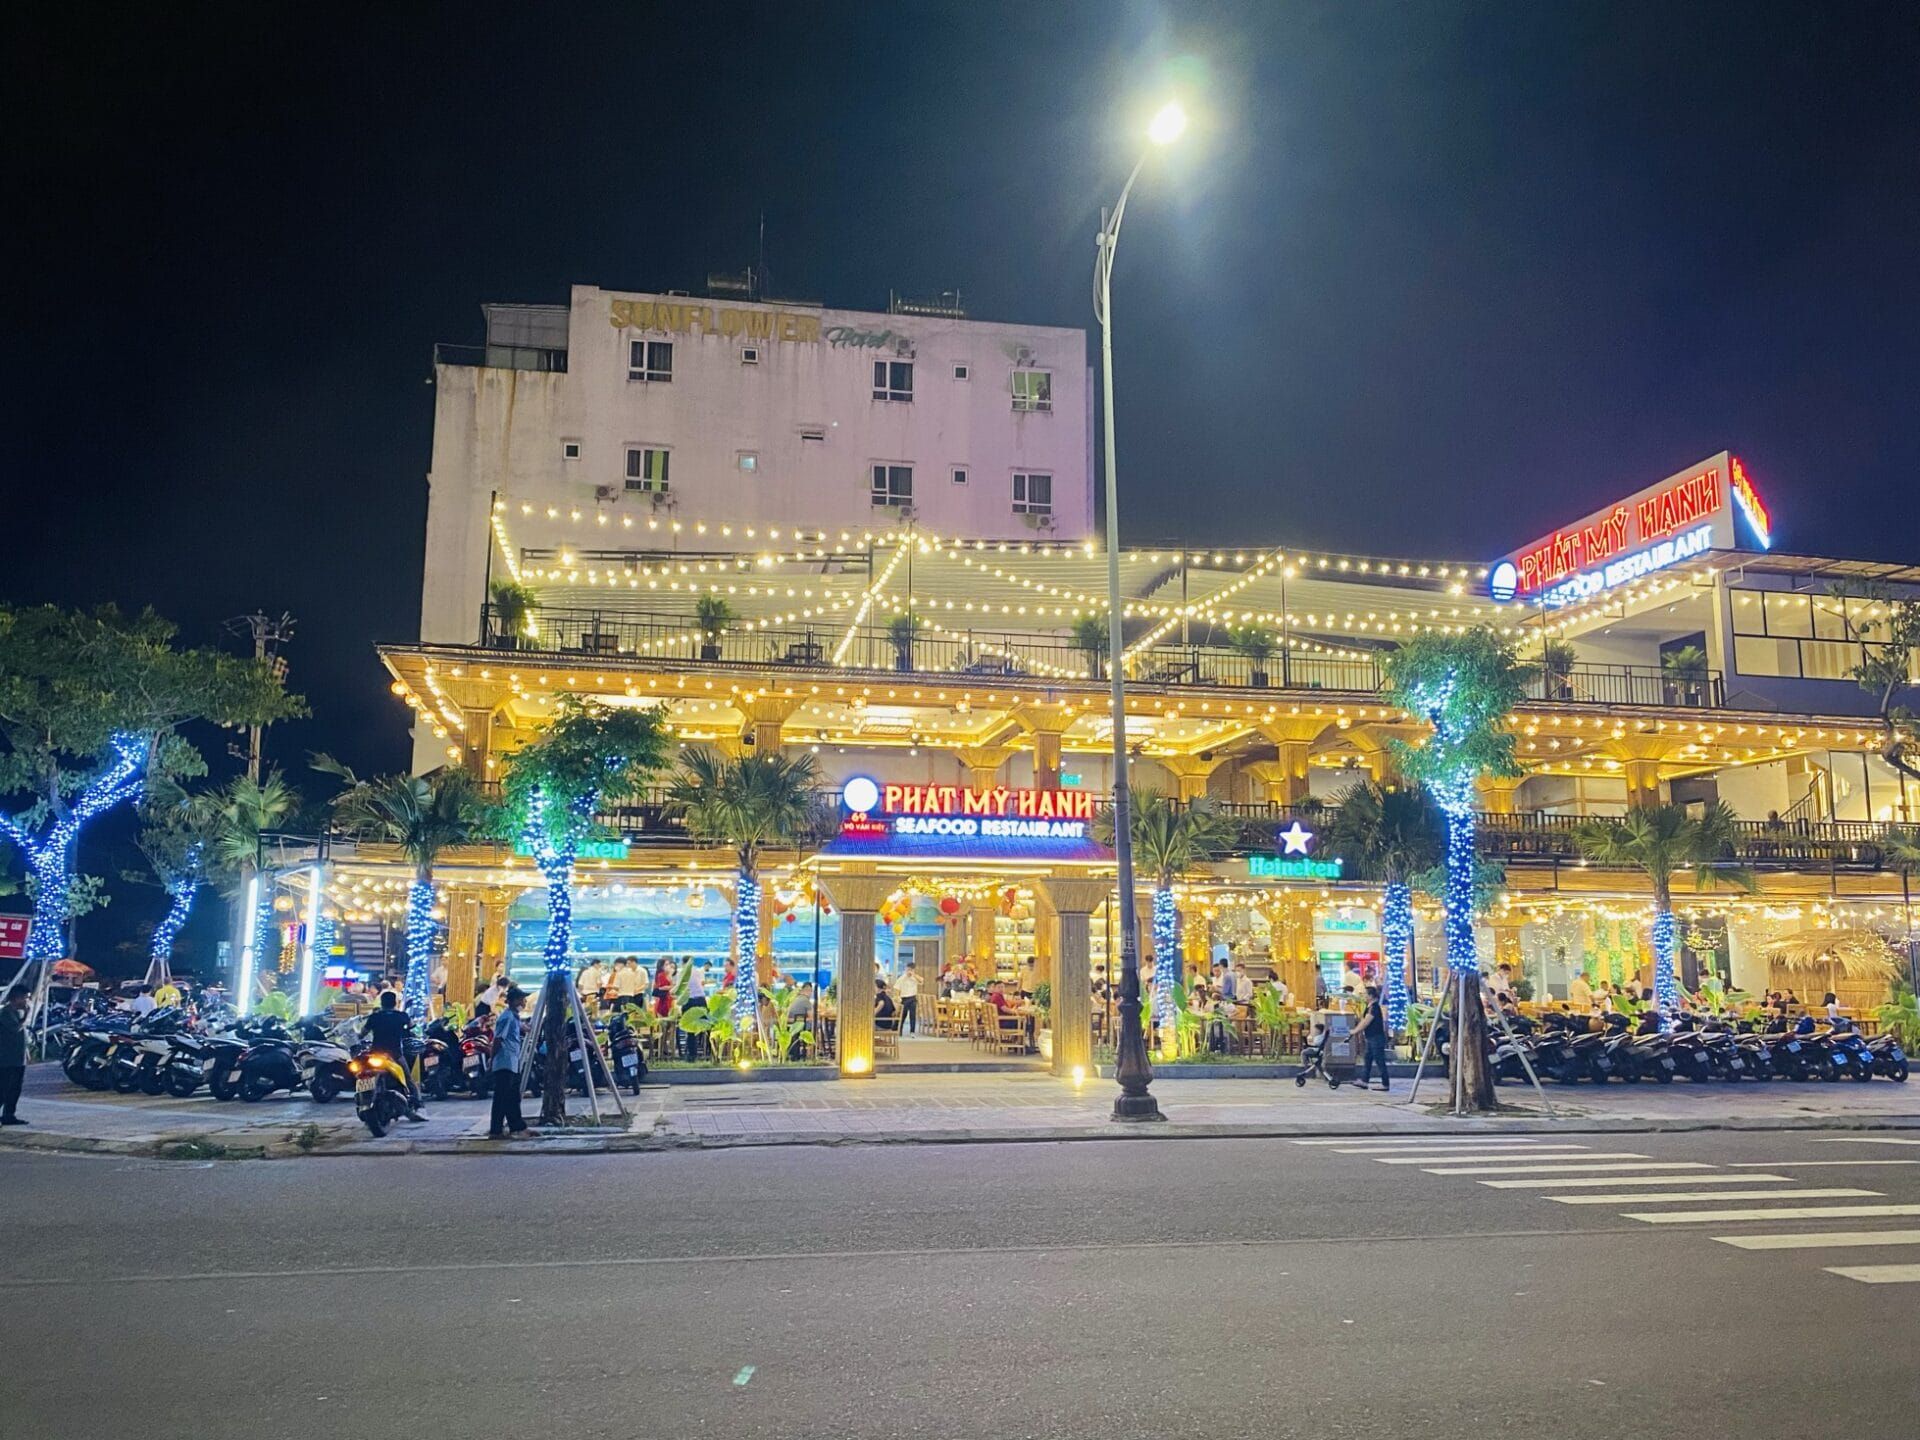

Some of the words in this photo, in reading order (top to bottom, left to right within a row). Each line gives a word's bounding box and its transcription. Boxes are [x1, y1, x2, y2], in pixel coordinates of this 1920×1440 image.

[609, 300, 821, 342] SUNFLOWER
[1521, 533, 1581, 591] PHÁT
[1584, 506, 1630, 565] MỸ
[1637, 469, 1722, 542] HẠNH
[1605, 525, 1713, 587] RESTAURANT
[851, 811, 867, 822] 69
[884, 782, 957, 814] PHÁT
[963, 785, 1011, 816] MỸ
[1018, 790, 1094, 820] HẠNH
[895, 816, 978, 835] SEAFOOD
[981, 819, 1085, 838] RESTAURANT
[1249, 857, 1340, 878] Heineken
